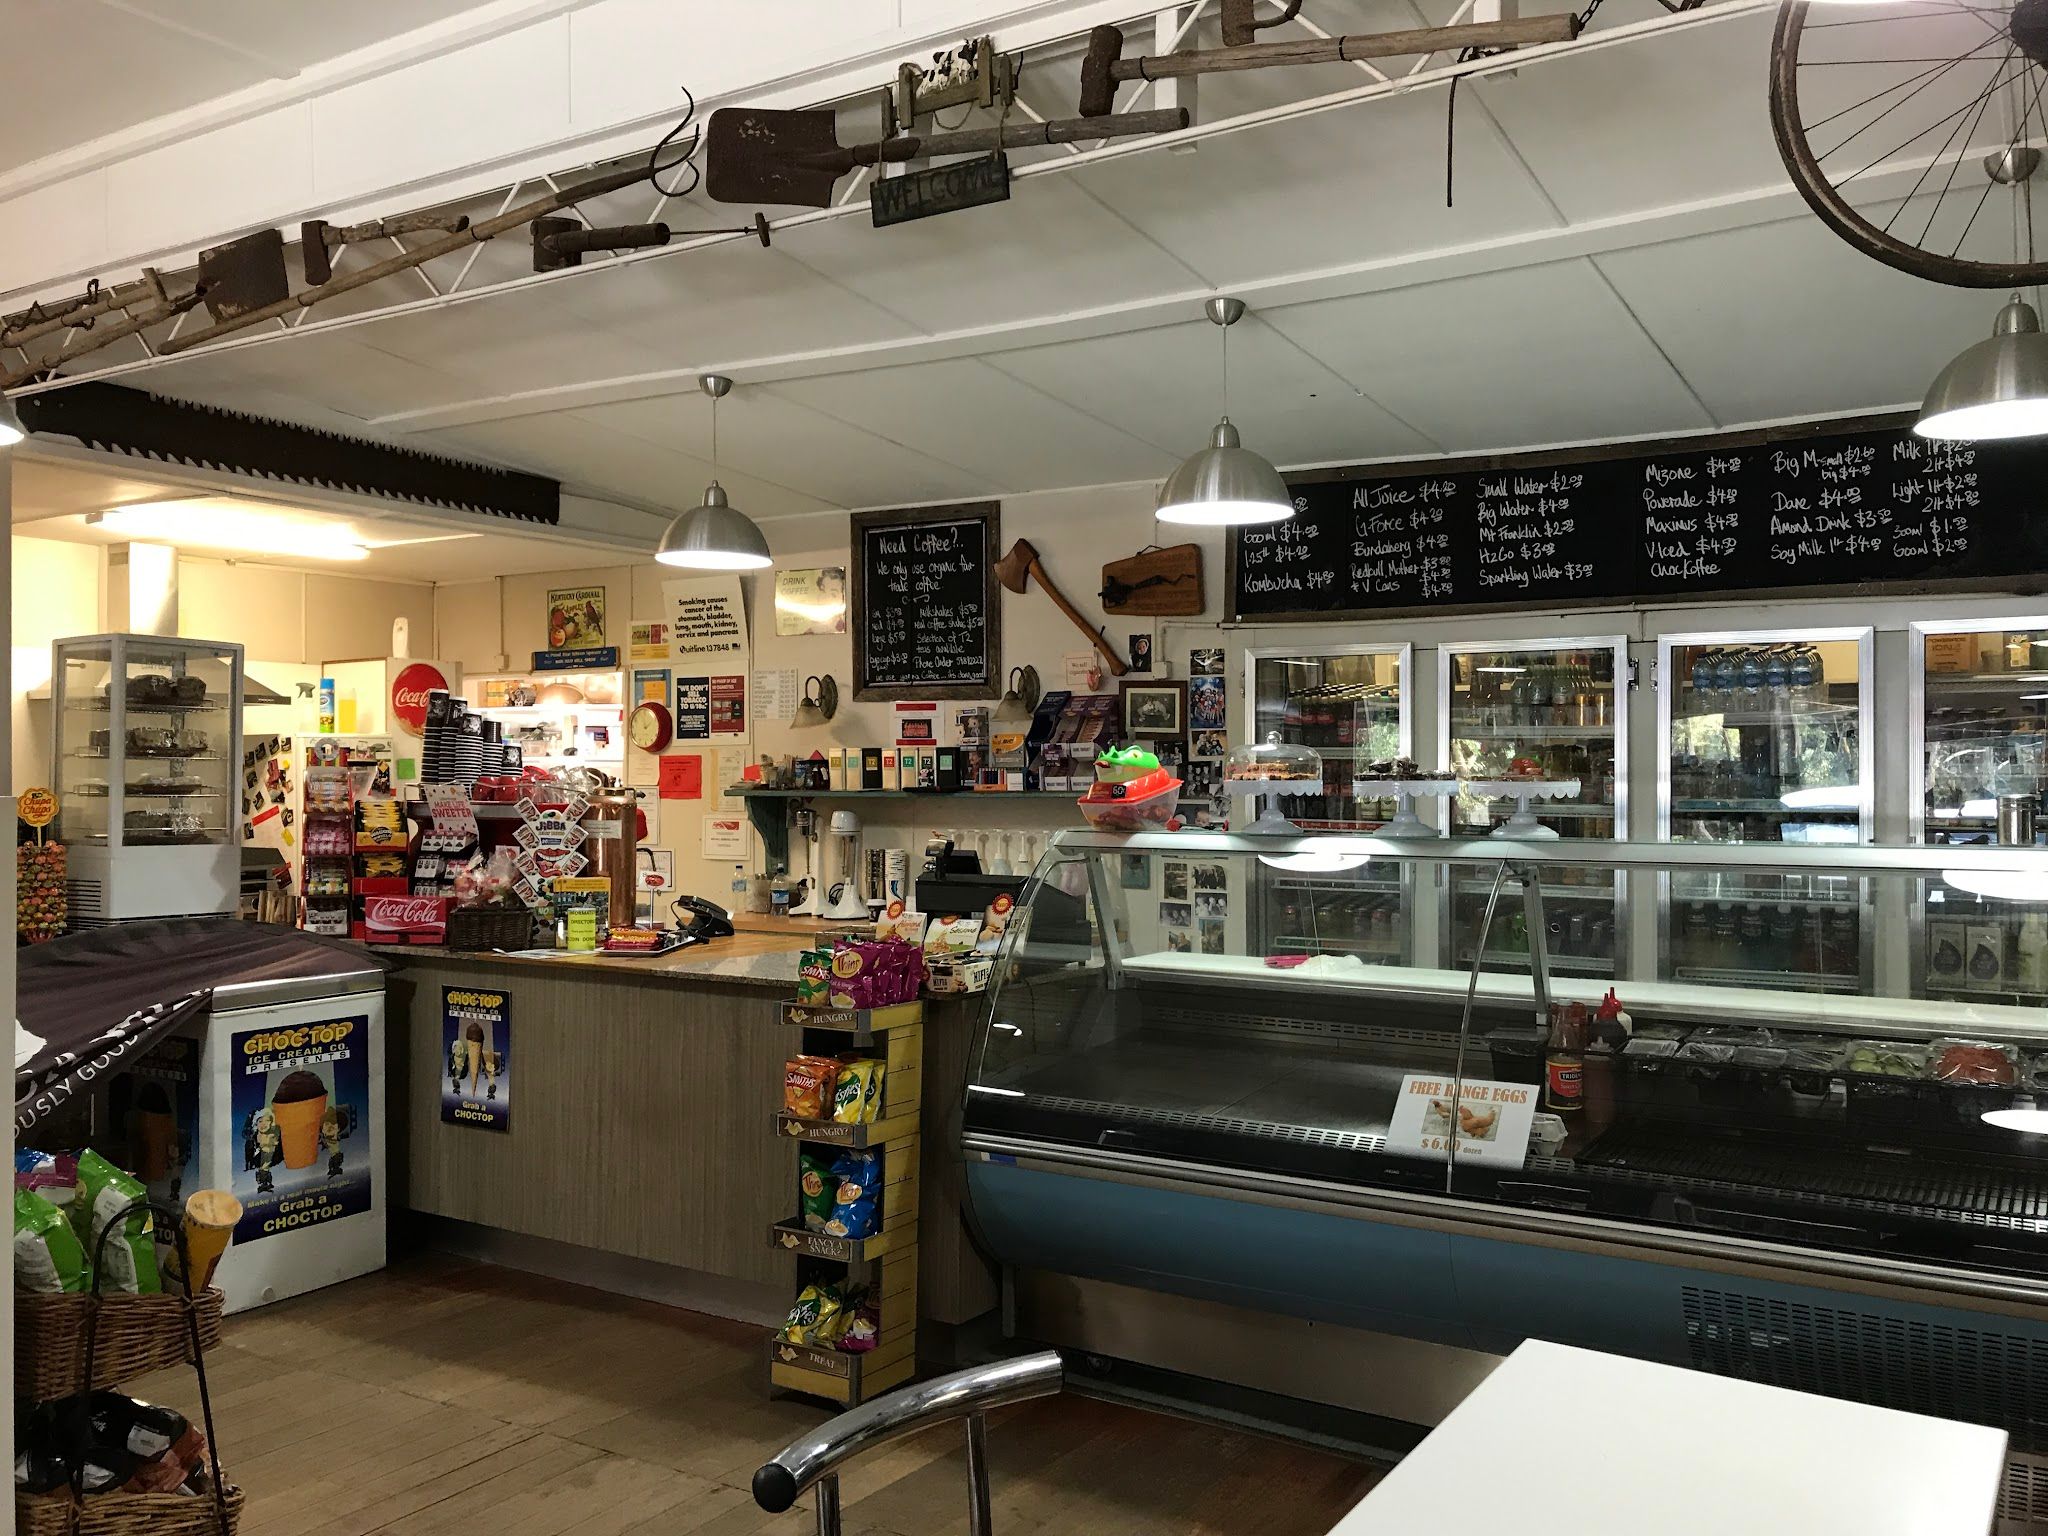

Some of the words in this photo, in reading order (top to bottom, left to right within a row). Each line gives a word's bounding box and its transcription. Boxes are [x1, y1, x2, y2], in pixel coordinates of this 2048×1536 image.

[1893, 440, 1921, 461] Milk
[1645, 463, 1698, 487] Mizone
[1706, 456, 1741, 478] $4.50
[1770, 450, 1799, 478] Big
[1476, 477, 1509, 499] Small
[1514, 476, 1548, 496] Water
[1550, 470, 1583, 492] $2.00
[1893, 479, 1924, 503] Light
[1353, 488, 1368, 509] All
[1369, 484, 1415, 508] Juice
[1642, 488, 1703, 511] Powerade
[1770, 491, 1812, 511] Dare
[1818, 487, 1862, 509] $4.00
[1477, 502, 1496, 527] Big
[1500, 499, 1534, 516] Water
[1770, 515, 1812, 535] Almond
[1815, 511, 1852, 532] Drink
[1479, 527, 1496, 542] Mt
[1498, 523, 1542, 541] Franklin
[879, 535, 907, 554] Need
[1350, 540, 1412, 558] Bundaberg
[1770, 544, 1796, 564] Soy
[1798, 539, 1825, 556] Milk
[1893, 540, 1928, 557] 600ml
[1479, 546, 1515, 564] H2Go
[893, 560, 908, 581] only
[911, 563, 926, 575] use
[928, 560, 957, 579] organic
[1388, 559, 1419, 577] Mother
[1479, 565, 1529, 588] Sparkling
[1532, 562, 1562, 580] Water
[782, 577, 807, 586] DRINK
[888, 578, 908, 592] trade
[1244, 572, 1302, 593] Kombucha
[1361, 580, 1370, 592] V
[1375, 579, 1400, 592] Cans
[678, 598, 706, 606] Smoking
[707, 596, 728, 604] causes
[684, 606, 705, 614] cancer
[713, 604, 724, 612] the
[674, 623, 691, 632] lung,
[691, 622, 714, 631] mouth,
[714, 620, 738, 629] kidney,
[678, 614, 706, 623] stomach,
[706, 612, 733, 621] bladder,
[927, 618, 947, 631] coffee
[676, 631, 696, 639] cervix
[697, 629, 710, 637] and
[710, 628, 739, 638] pancreas
[947, 631, 957, 644] of
[958, 631, 973, 643] T2
[679, 643, 705, 654] Quitline
[913, 656, 934, 668] Phone
[934, 654, 953, 668] Order
[395, 687, 430, 708] Coca-C
[22, 804, 51, 818] Chups
[23, 796, 52, 808] Chupa
[432, 806, 473, 819] SWEETER
[834, 957, 860, 973] Thins
[447, 990, 503, 1009] CHOCTOP
[450, 1011, 500, 1021] PRESENTS
[463, 1006, 487, 1014] CREAM
[813, 1013, 853, 1024] HUNGRY?
[243, 1021, 353, 1055] CHOCTOP
[248, 1054, 270, 1065] ICE
[278, 1046, 323, 1059] CREAM
[329, 1042, 349, 1052] CO.
[250, 1051, 347, 1073] PRESENTS
[1408, 1080, 1442, 1097] FREE
[1444, 1083, 1489, 1101] RANGE
[1491, 1087, 1528, 1105] EGGS
[454, 1108, 493, 1122] CHOCTOP
[462, 1101, 480, 1111] Grab
[809, 1127, 848, 1137] HUNGRY?
[1462, 1146, 1483, 1155] dozen
[247, 1198, 269, 1208] Make
[286, 1190, 302, 1200] real
[304, 1185, 328, 1196] movie
[279, 1196, 314, 1214] Grab
[317, 1194, 327, 1204] a
[263, 1203, 343, 1233] CHOCTOP
[807, 1236, 835, 1247] FANCY
[810, 1243, 841, 1256] SNACK?
[809, 1352, 835, 1369] TREAT
